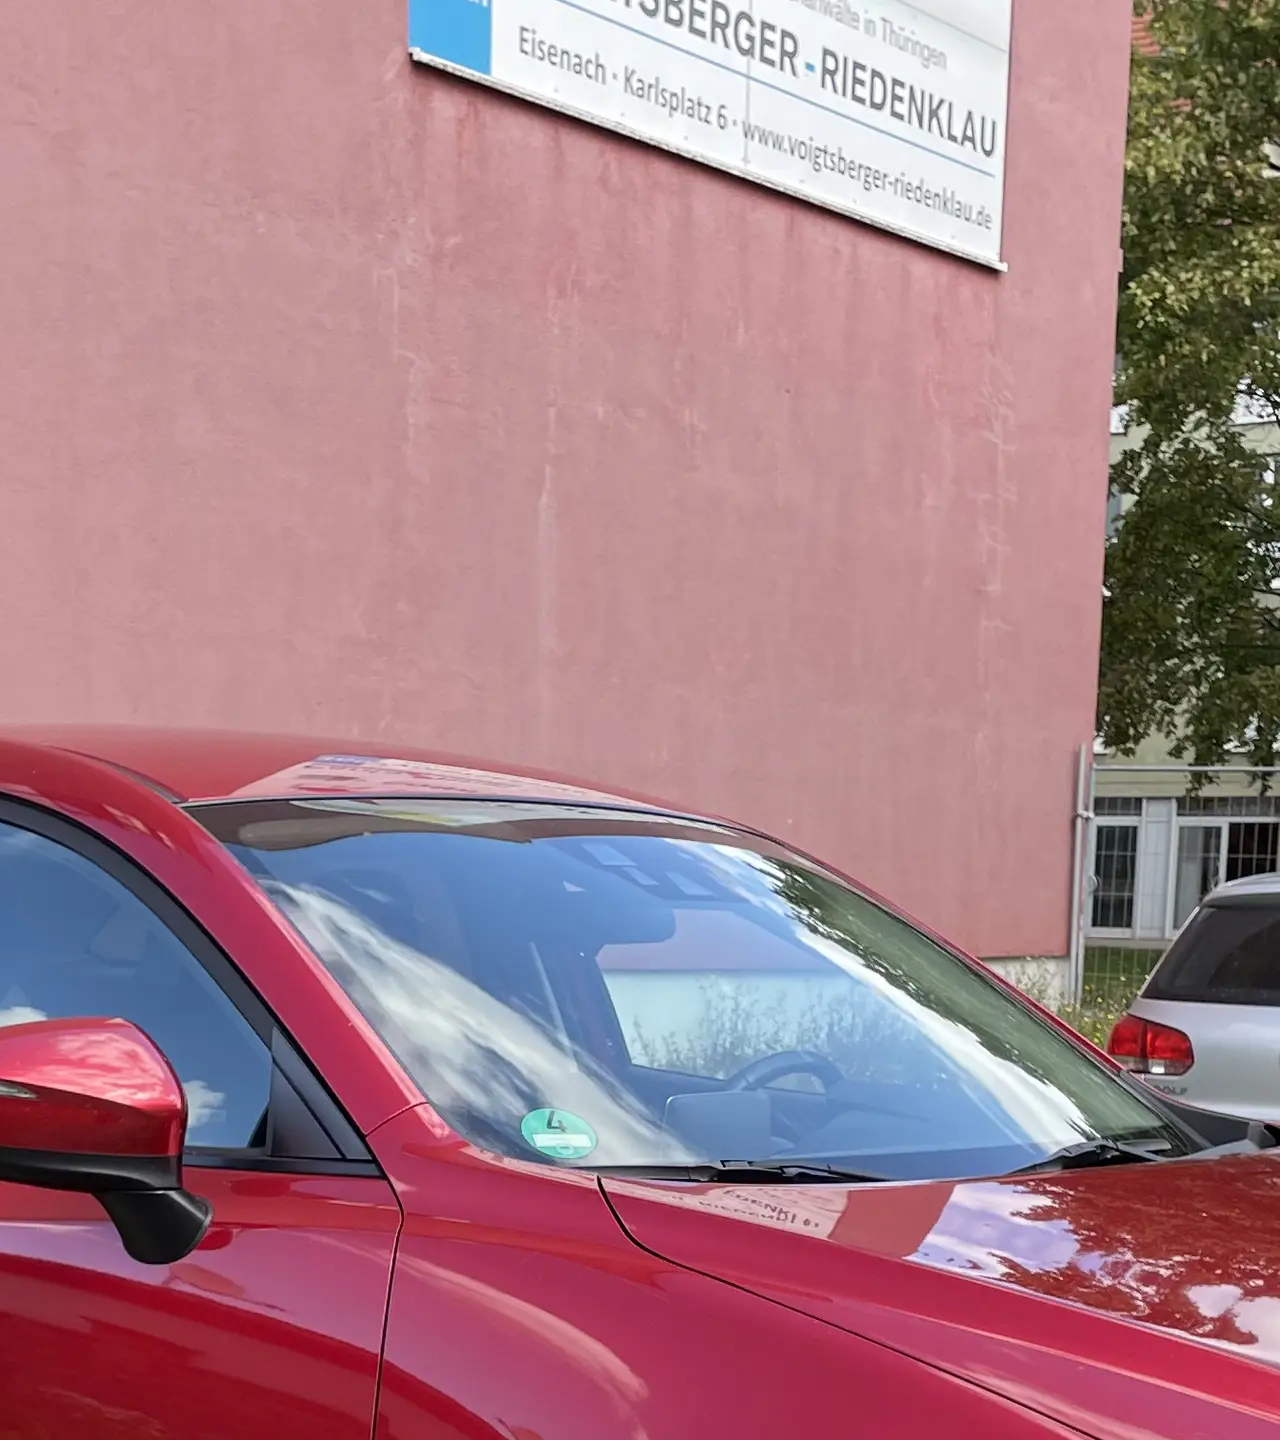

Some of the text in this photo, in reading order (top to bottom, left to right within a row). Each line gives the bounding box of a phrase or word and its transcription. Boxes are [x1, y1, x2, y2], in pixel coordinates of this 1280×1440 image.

[880, 17, 947, 70] Thüringen
[519, 26, 993, 231] Eisenach Karlsplatz 6 www.voigtsberger-riedenklau.de
[546, 1110, 567, 1134] 4
